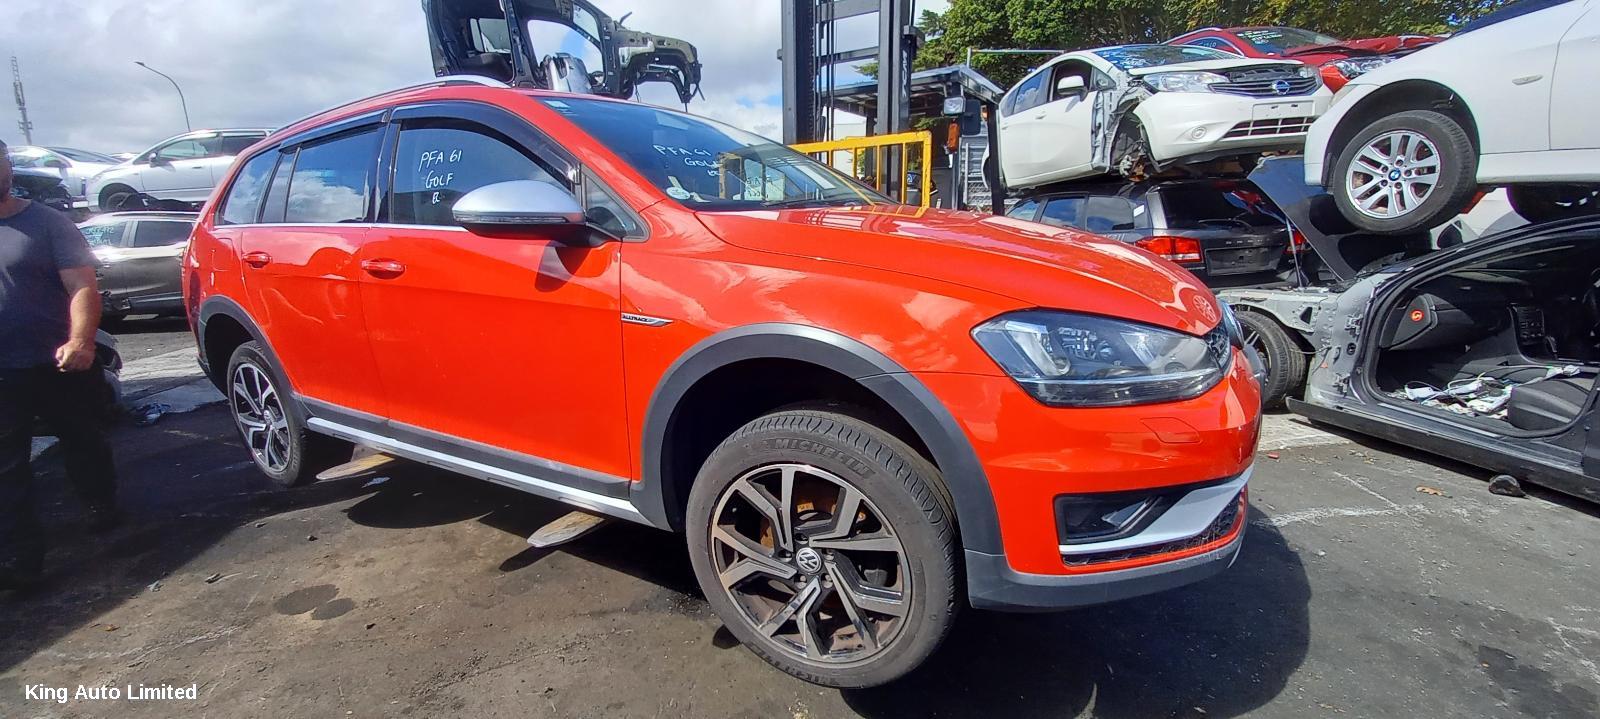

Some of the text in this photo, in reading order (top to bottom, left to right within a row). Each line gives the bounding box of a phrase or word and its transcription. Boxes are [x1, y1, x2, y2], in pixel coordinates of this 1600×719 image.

[653, 144, 692, 156] PFA
[418, 149, 462, 173] PFA 61
[425, 170, 454, 189] GOLF
[774, 439, 874, 479] MICHELIN
